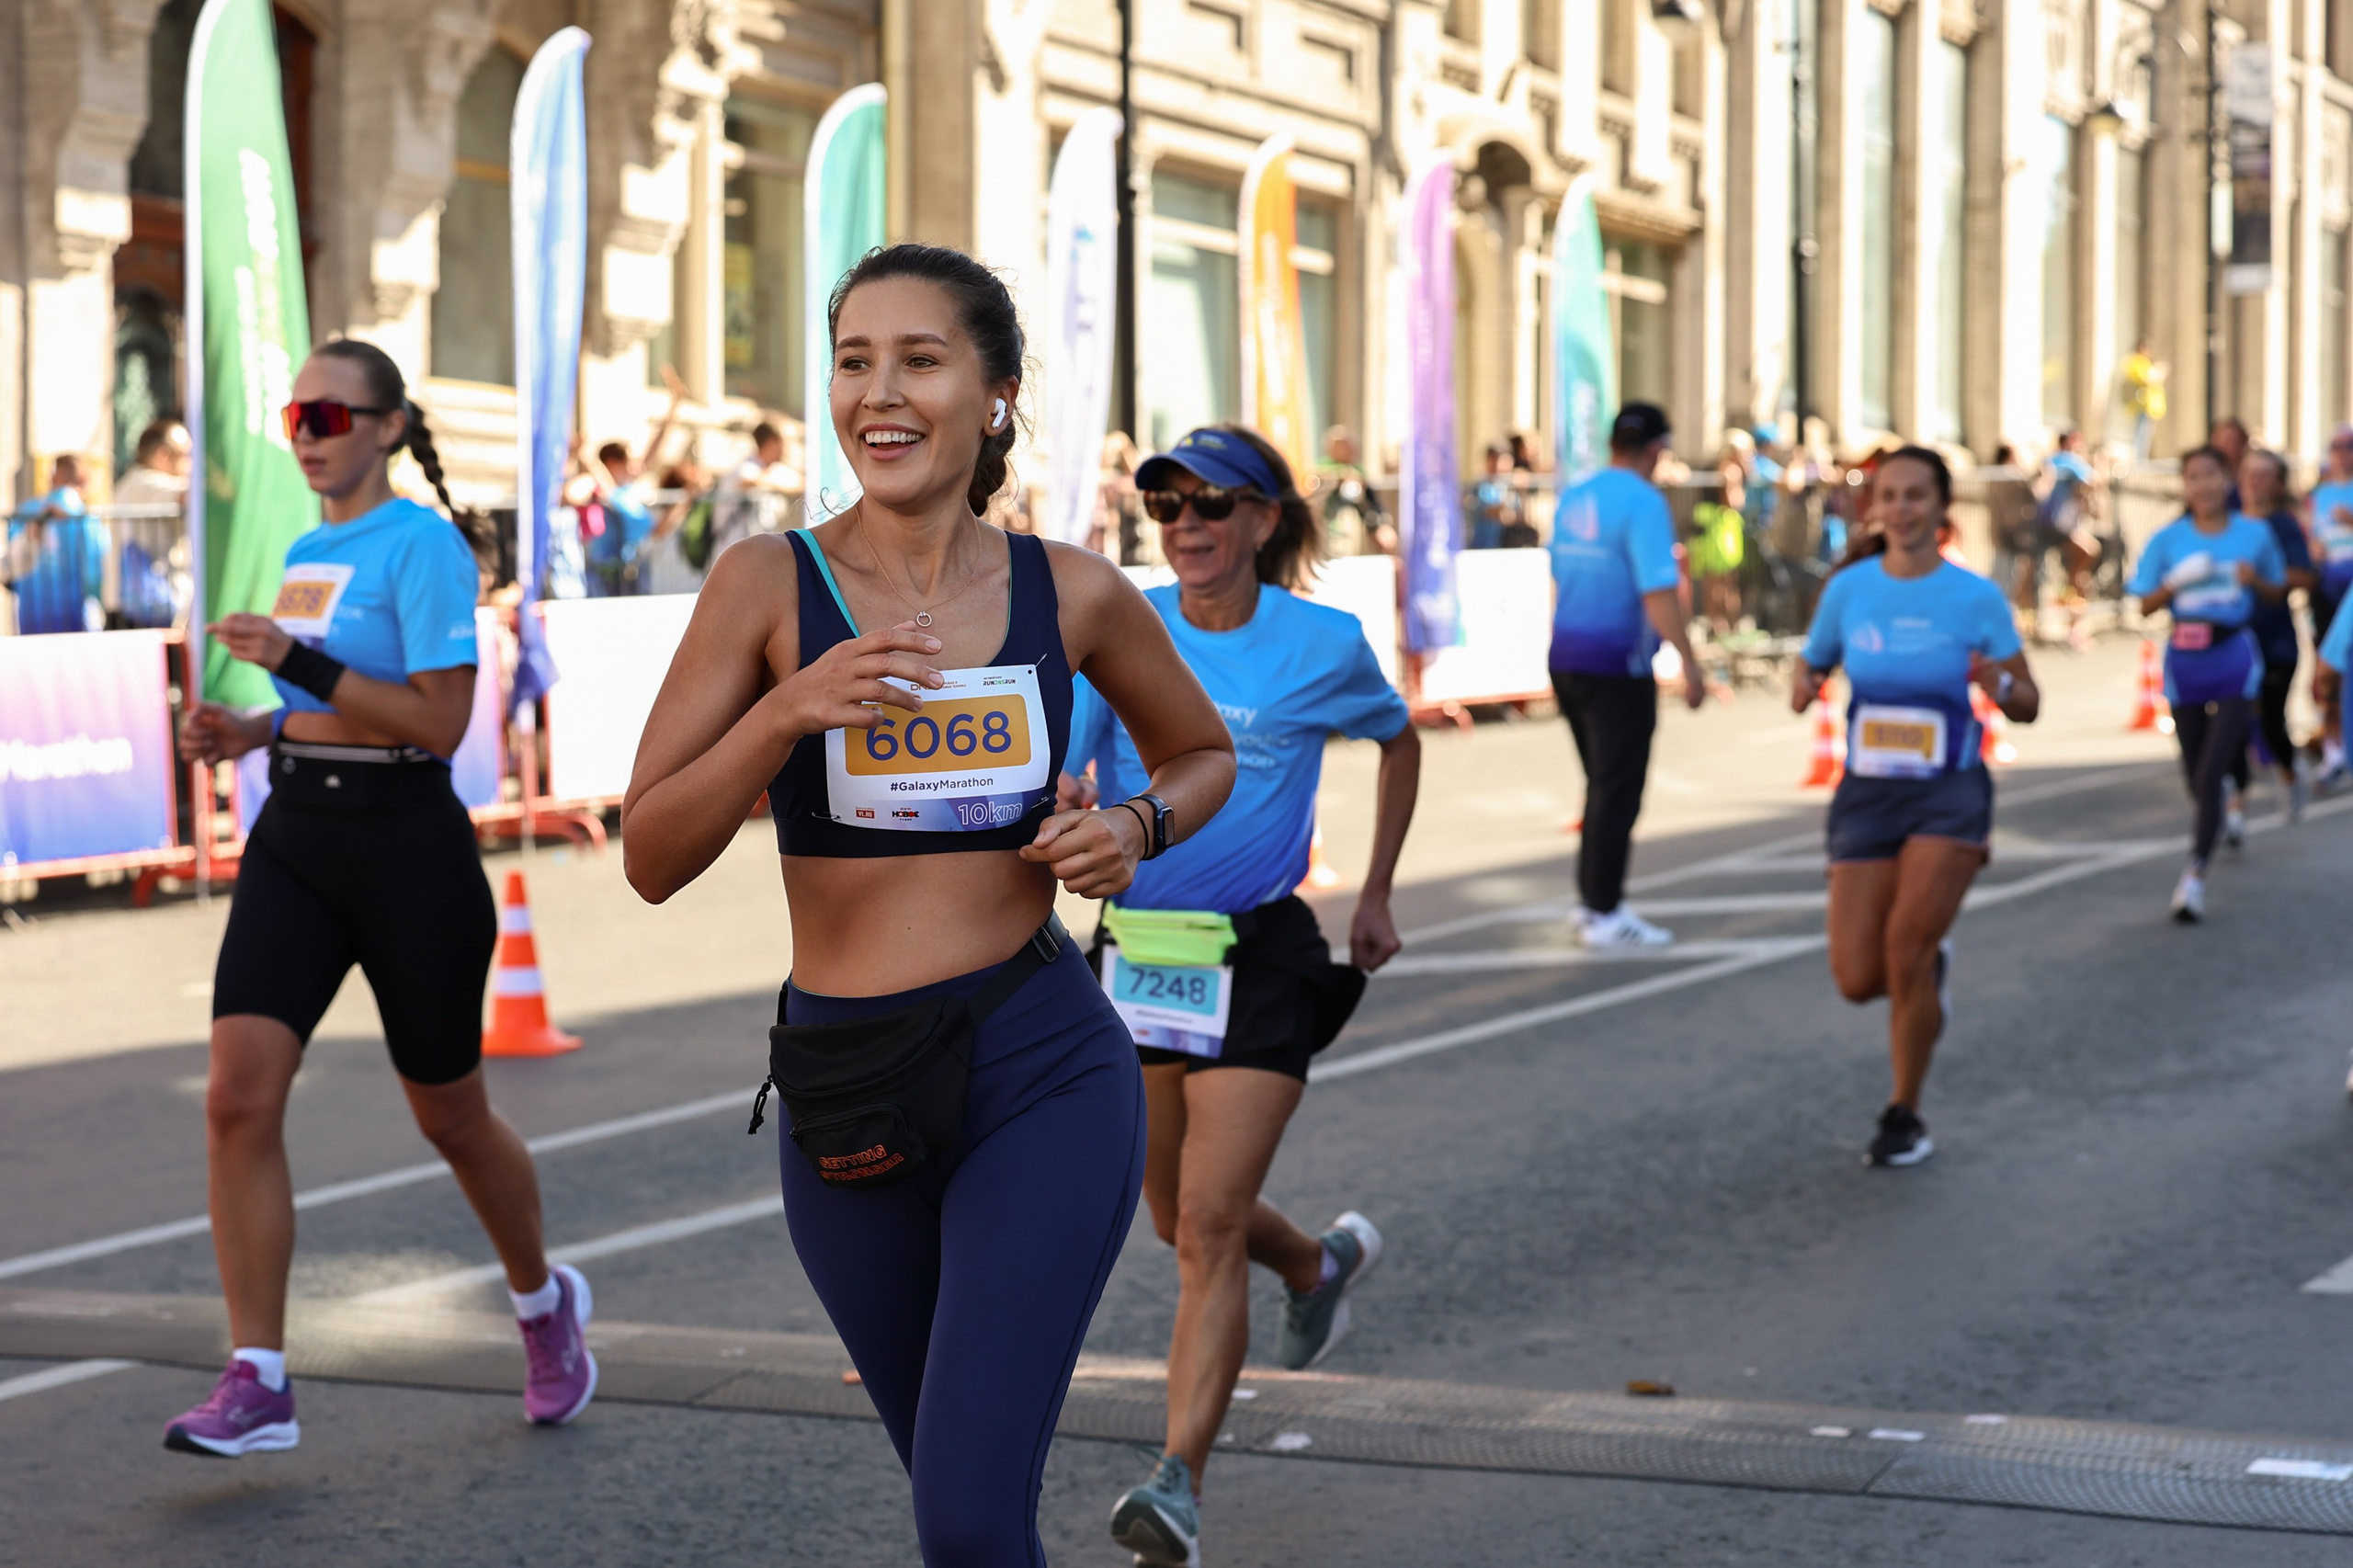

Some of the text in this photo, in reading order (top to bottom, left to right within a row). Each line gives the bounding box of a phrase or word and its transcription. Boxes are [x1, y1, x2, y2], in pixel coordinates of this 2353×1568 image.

[866, 710, 1012, 761] 6068
[890, 778, 994, 791] #GalaxyMarathon
[958, 801, 1023, 825] 10km
[1129, 966, 1207, 1006] 7248
[818, 1144, 888, 1169] GETTING
[818, 1153, 905, 1181] STRONGER
